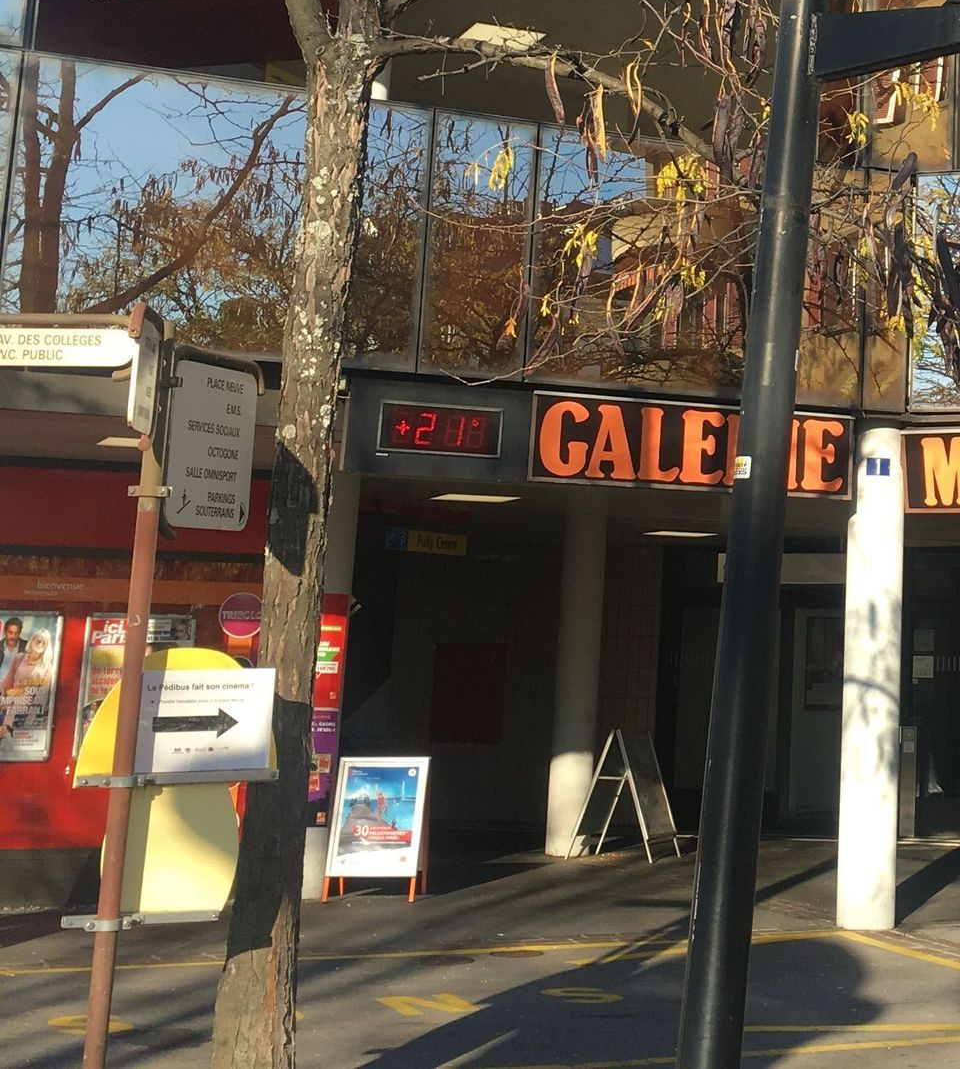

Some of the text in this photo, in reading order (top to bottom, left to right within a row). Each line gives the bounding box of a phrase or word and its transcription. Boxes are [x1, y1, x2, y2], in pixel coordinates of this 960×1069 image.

[18, 334, 40, 345] DES
[22, 349, 63, 360] PUBLIC
[207, 377, 244, 394] PLACE NEUVE
[188, 420, 240, 437] SERVICES SOCIAUX
[208, 446, 238, 460] OCTOGONE
[186, 467, 237, 482] SALLE OMNISPORT
[208, 492, 235, 505] PARKINGS
[195, 505, 234, 518] SOUTERRAINS
[160, 682, 189, 691] Pédibus
[192, 682, 204, 690] fait
[353, 825, 369, 836] 30
